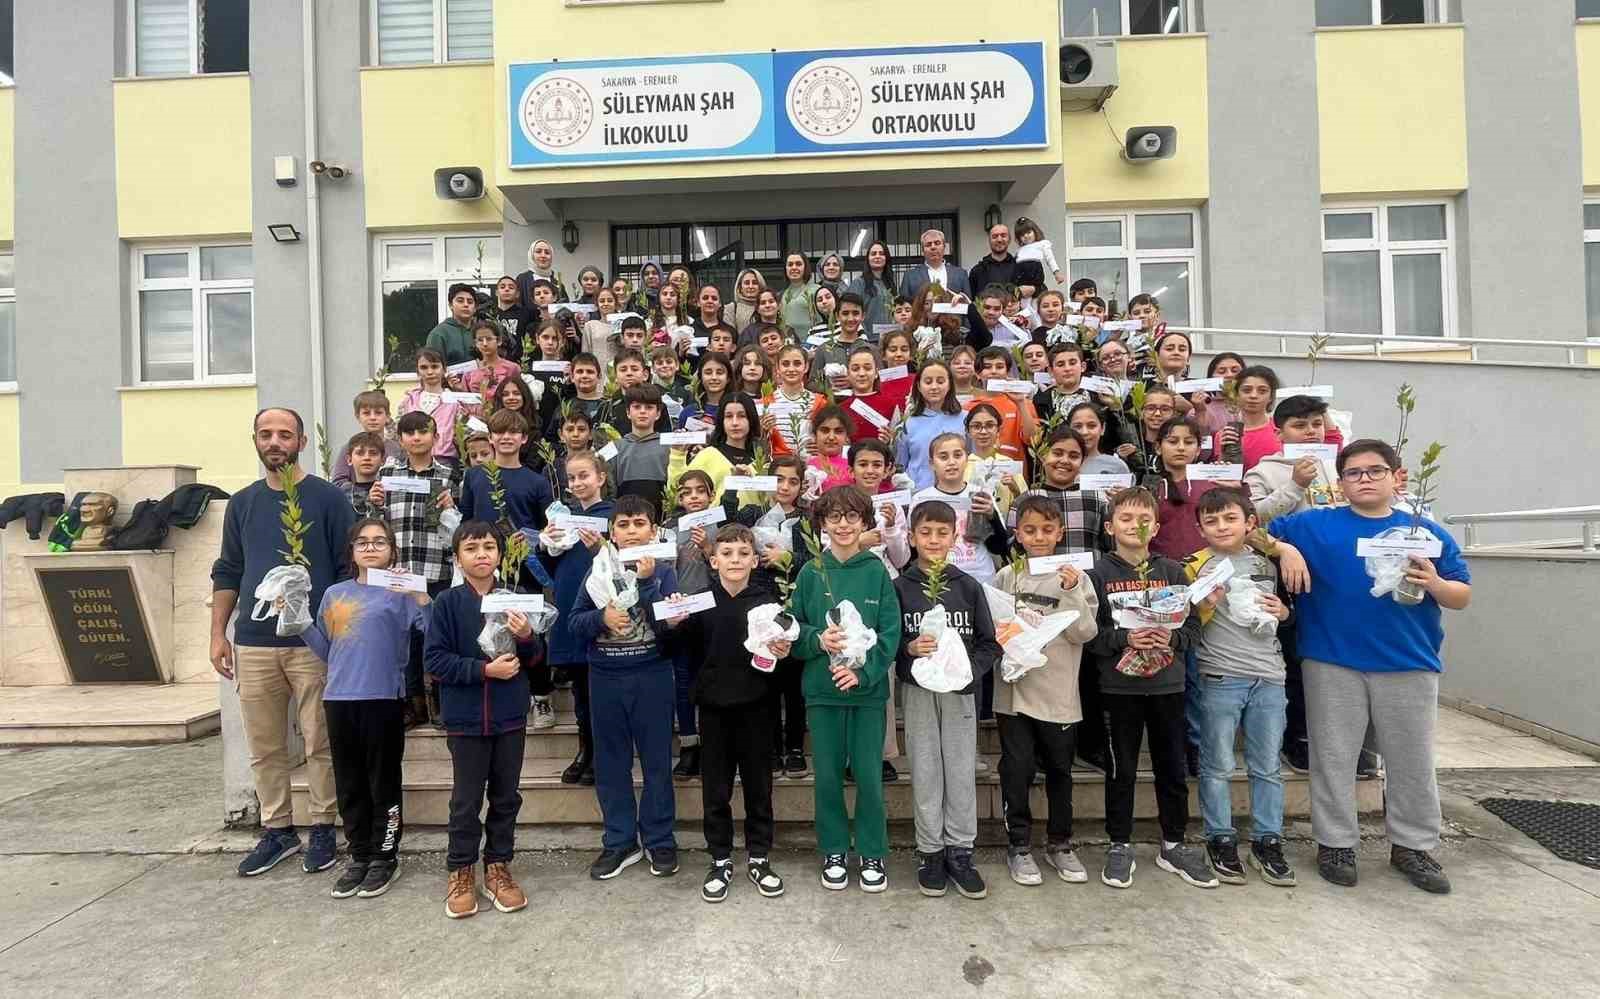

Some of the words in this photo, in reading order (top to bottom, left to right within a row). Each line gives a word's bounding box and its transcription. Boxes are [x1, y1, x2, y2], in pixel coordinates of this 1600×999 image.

[870, 65, 905, 76] SAKARYA
[912, 63, 948, 74] ERENLER
[601, 76, 637, 88] SAKARYA
[643, 74, 679, 86] ERENLER
[871, 81, 966, 104] SÜLEYMAN
[970, 80, 1005, 105] ŞAH
[602, 92, 696, 115] SÜLEYMAN
[700, 91, 735, 116] ŞAH
[872, 112, 976, 135] ORTAOKULU
[604, 123, 688, 146] İLKOKULU
[66, 587, 113, 599] TÜRK!
[903, 611, 970, 629] COROL
